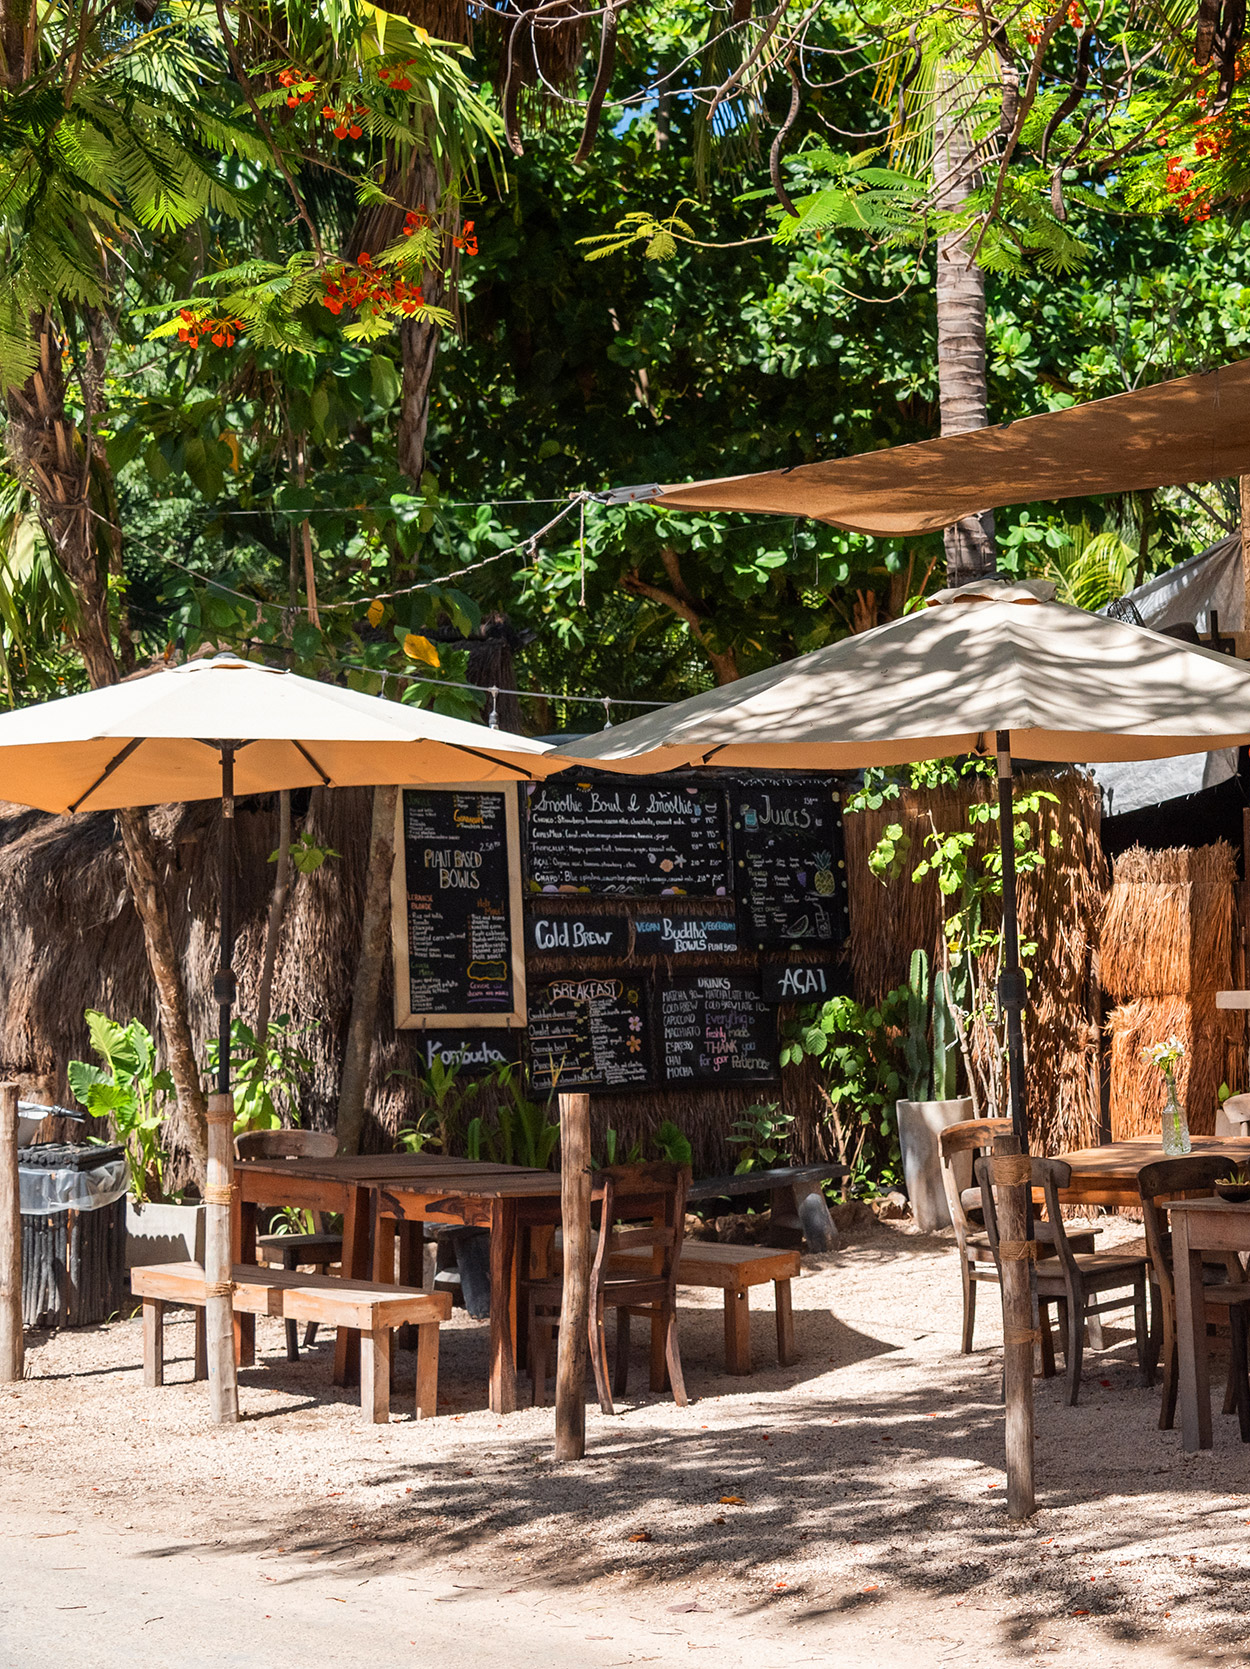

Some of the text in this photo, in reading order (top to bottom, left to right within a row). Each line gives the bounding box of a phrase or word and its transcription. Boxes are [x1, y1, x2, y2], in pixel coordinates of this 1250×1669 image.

[531, 789, 584, 812] Smoothie
[588, 792, 624, 813] Bowl
[645, 793, 693, 814] Smoothie
[759, 794, 811, 829] JUICES
[424, 848, 483, 869] PLANT BASED
[439, 867, 481, 890] BOWLS
[535, 920, 614, 950] Cold BREW
[636, 922, 661, 933] VEGAN
[661, 918, 708, 941] Buddha
[674, 939, 707, 953] BOWLS
[552, 982, 617, 1002] BREAKFAST
[697, 977, 732, 990] DRINKS
[662, 1003, 680, 1014] COLD
[427, 1040, 508, 1070] Kombucha
[704, 1039, 738, 1054] THANK
[665, 1055, 682, 1067] CHAI
[699, 1053, 712, 1068] for
[712, 1055, 729, 1072] your
[666, 1066, 694, 1080] MOCHA
